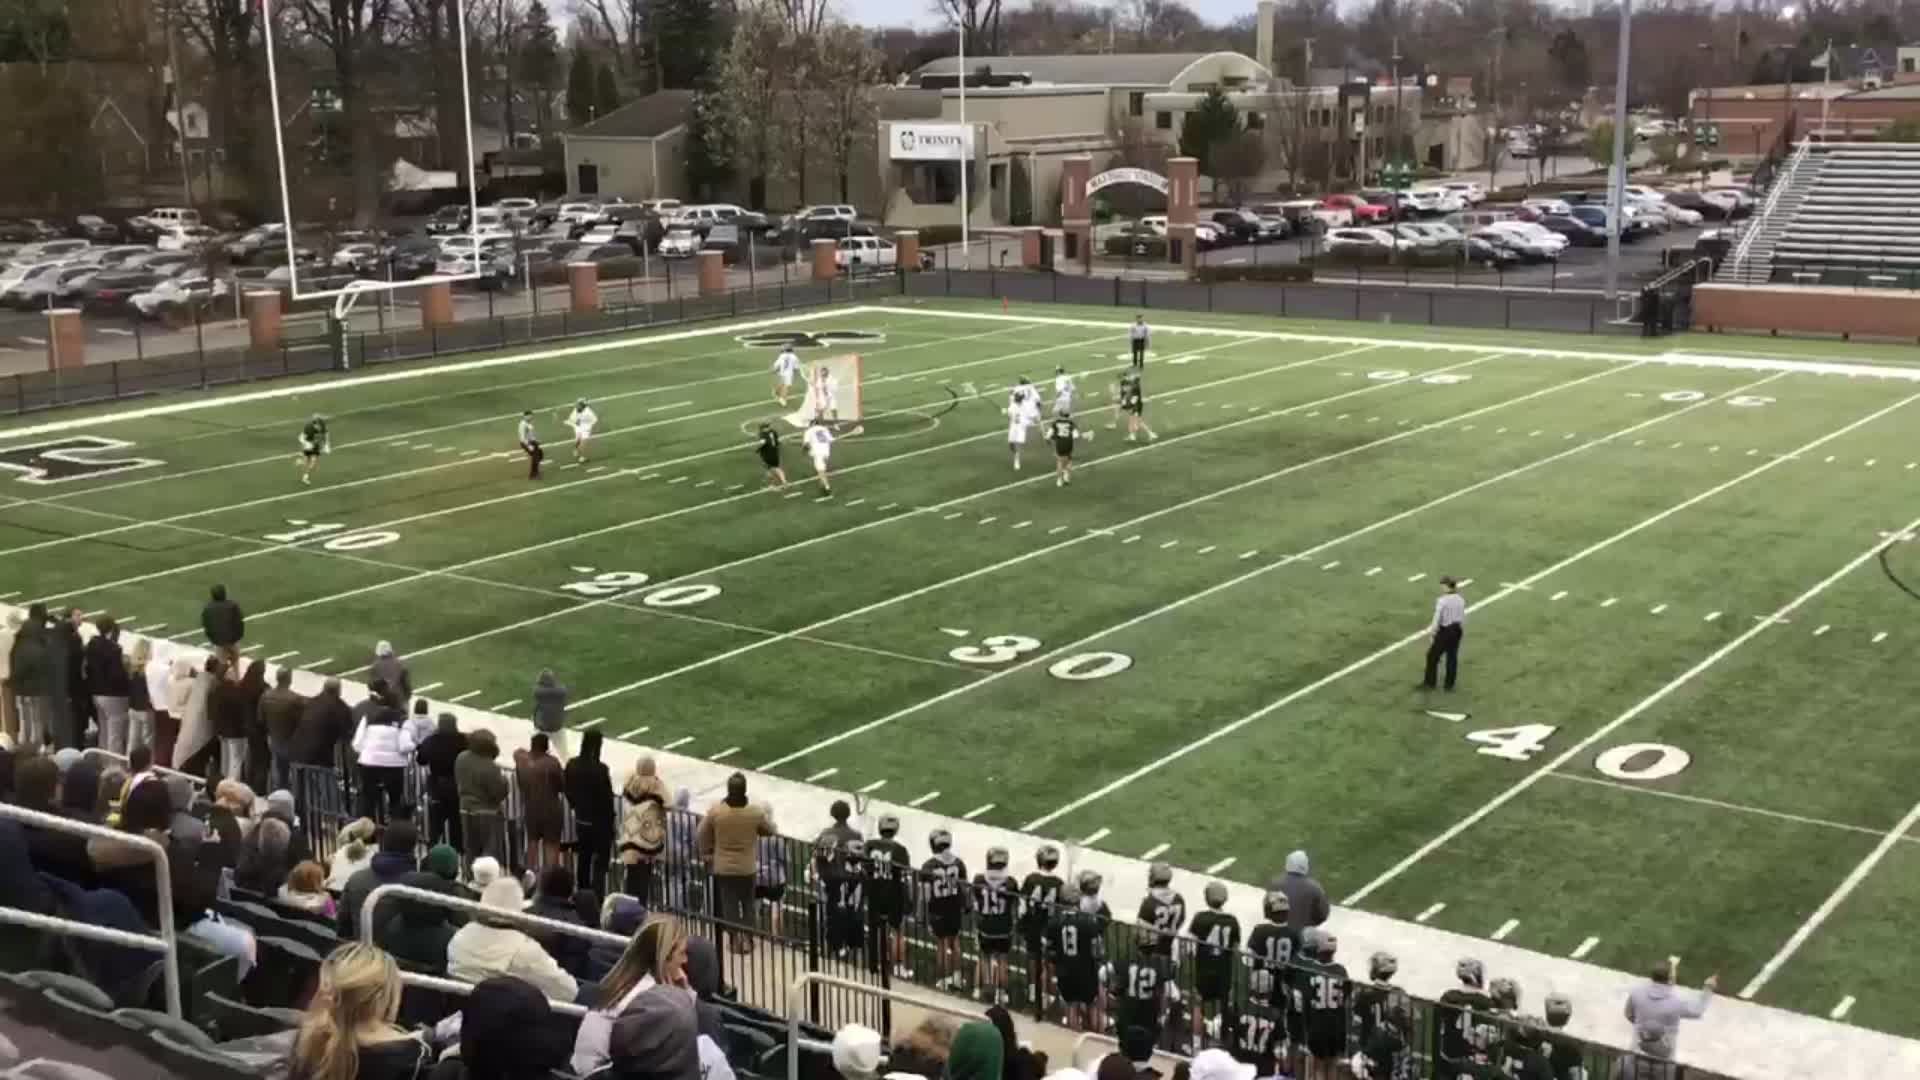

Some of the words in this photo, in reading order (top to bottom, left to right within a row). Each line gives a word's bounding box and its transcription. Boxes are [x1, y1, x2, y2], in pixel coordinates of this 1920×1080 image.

[949, 635, 1132, 680] 30
[1465, 723, 1692, 779] 40
[1128, 964, 1157, 999] 12
